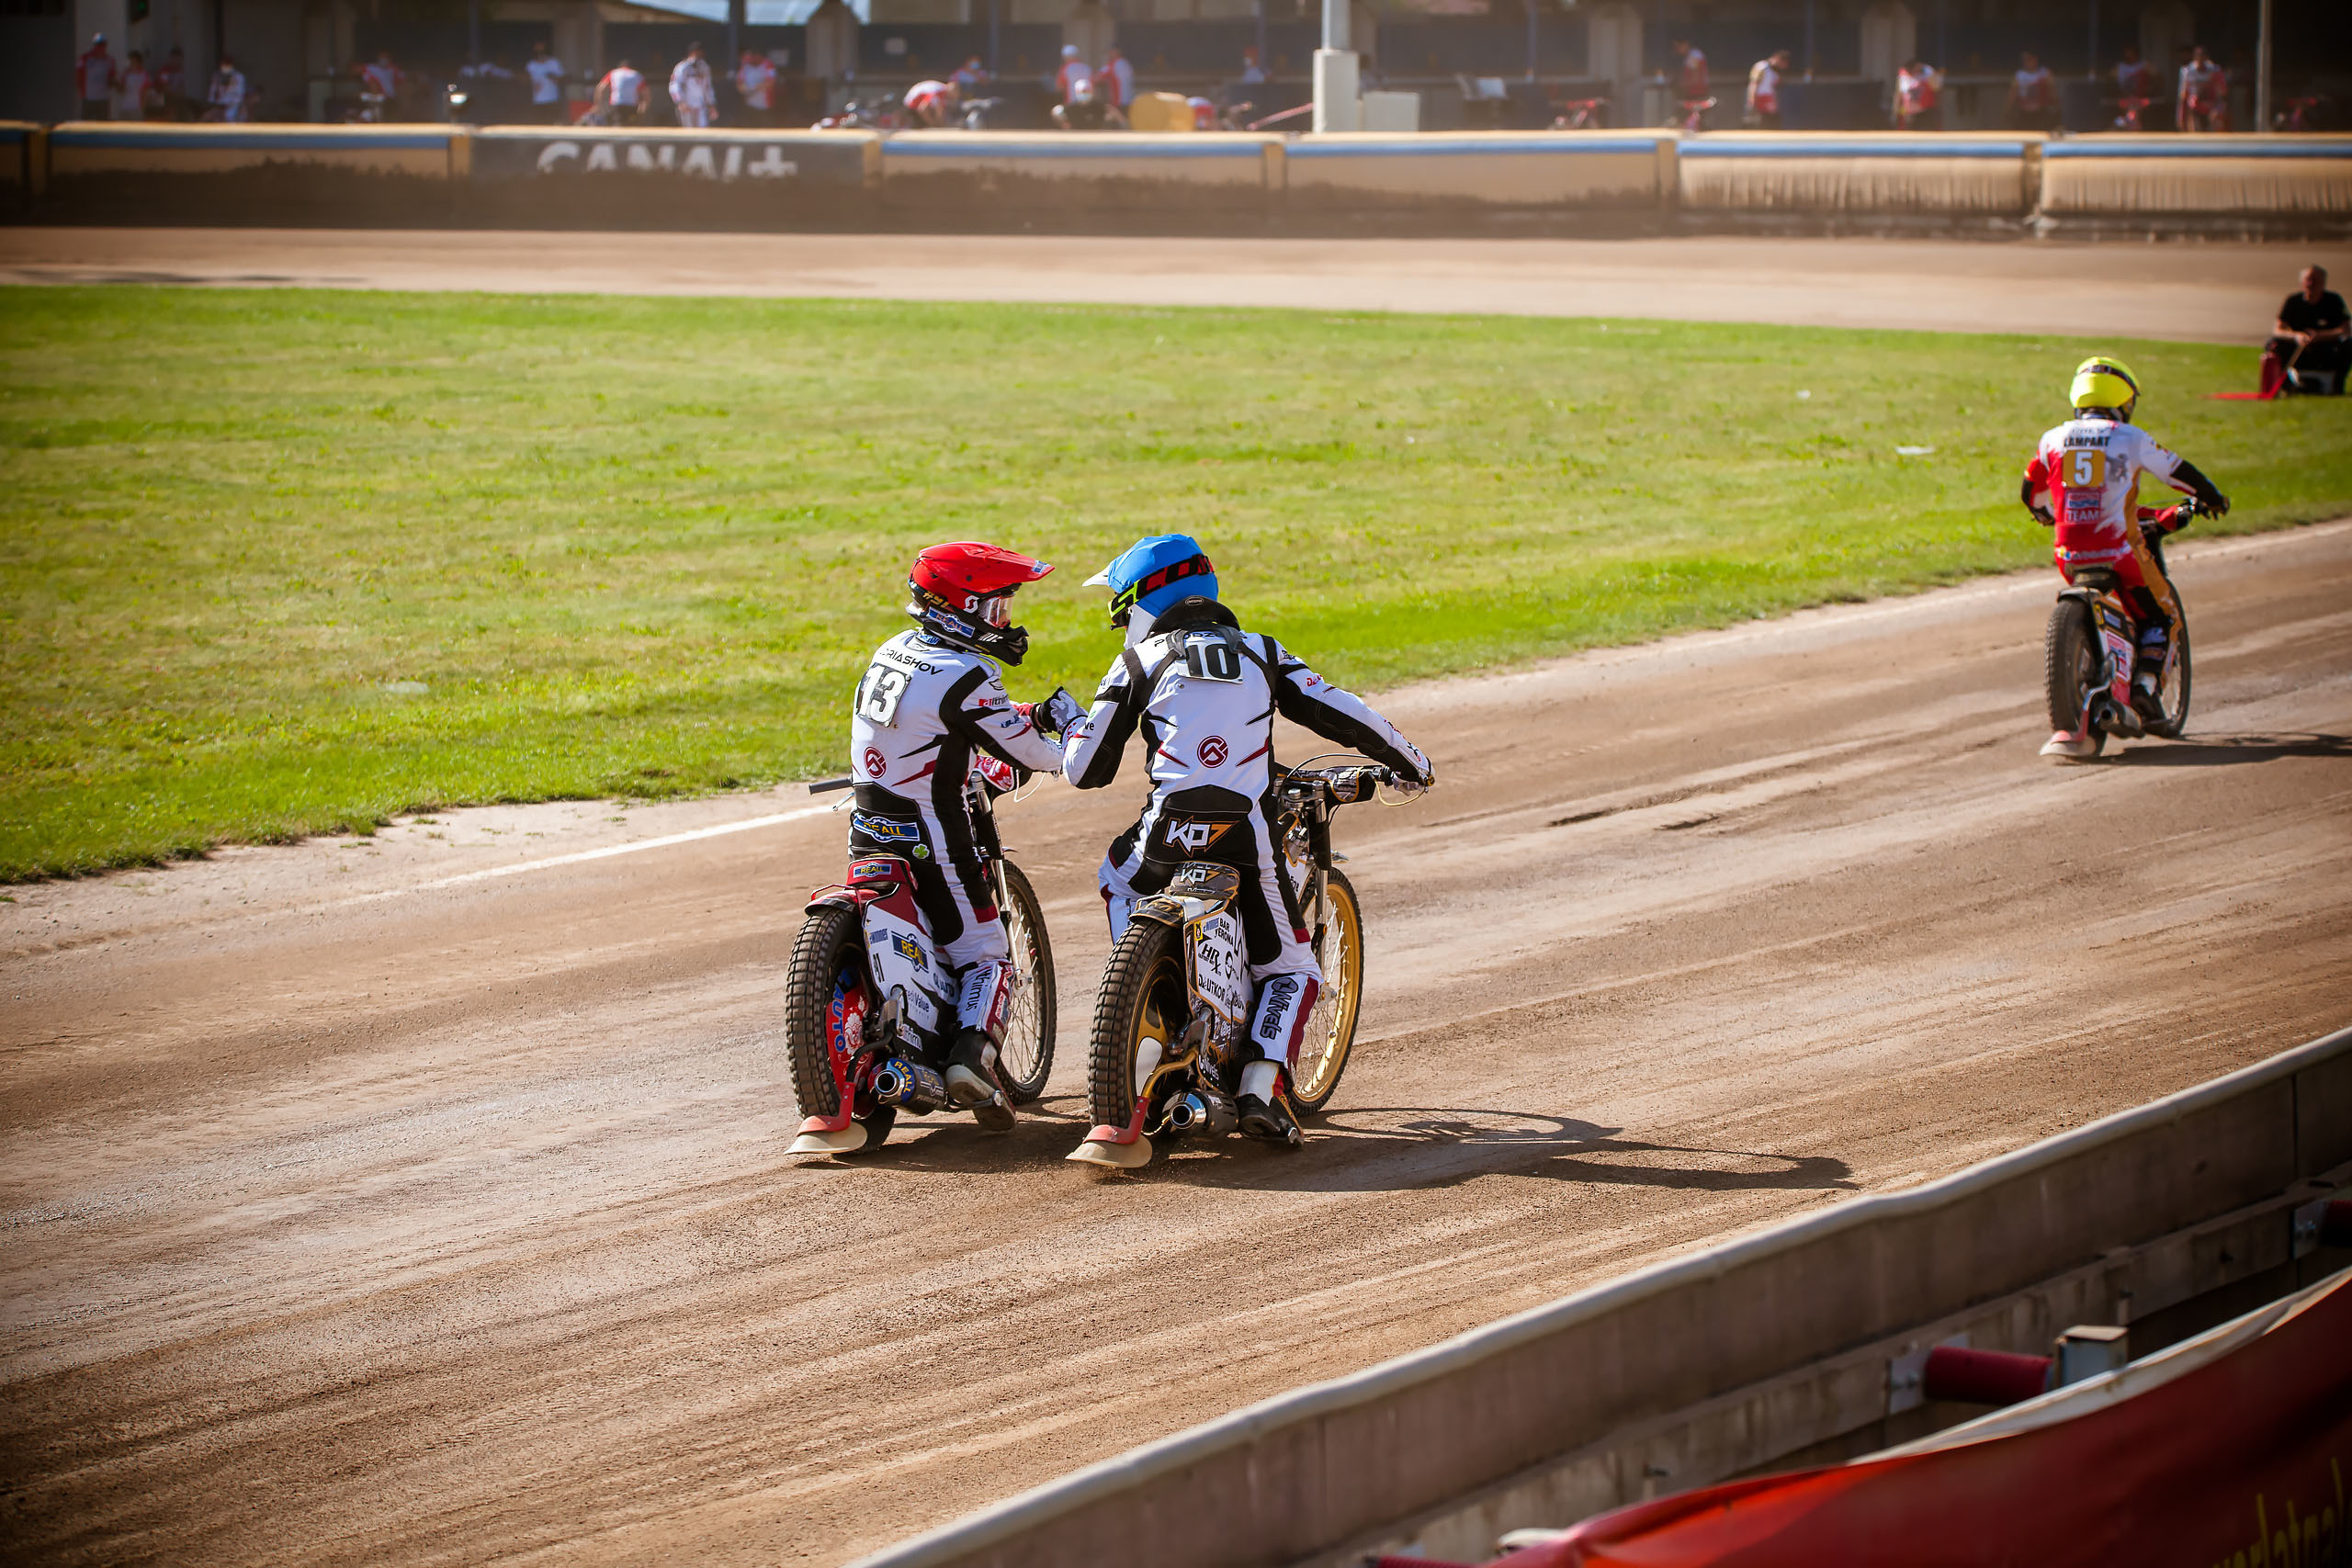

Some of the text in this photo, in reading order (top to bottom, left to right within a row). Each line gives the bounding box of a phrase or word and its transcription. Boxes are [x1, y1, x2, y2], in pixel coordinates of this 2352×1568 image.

[2064, 435, 2110, 447] LAMPART
[2074, 451, 2093, 485] 5
[1186, 643, 1240, 680] 10
[857, 664, 907, 723] 13
[894, 1061, 912, 1093] REALL
